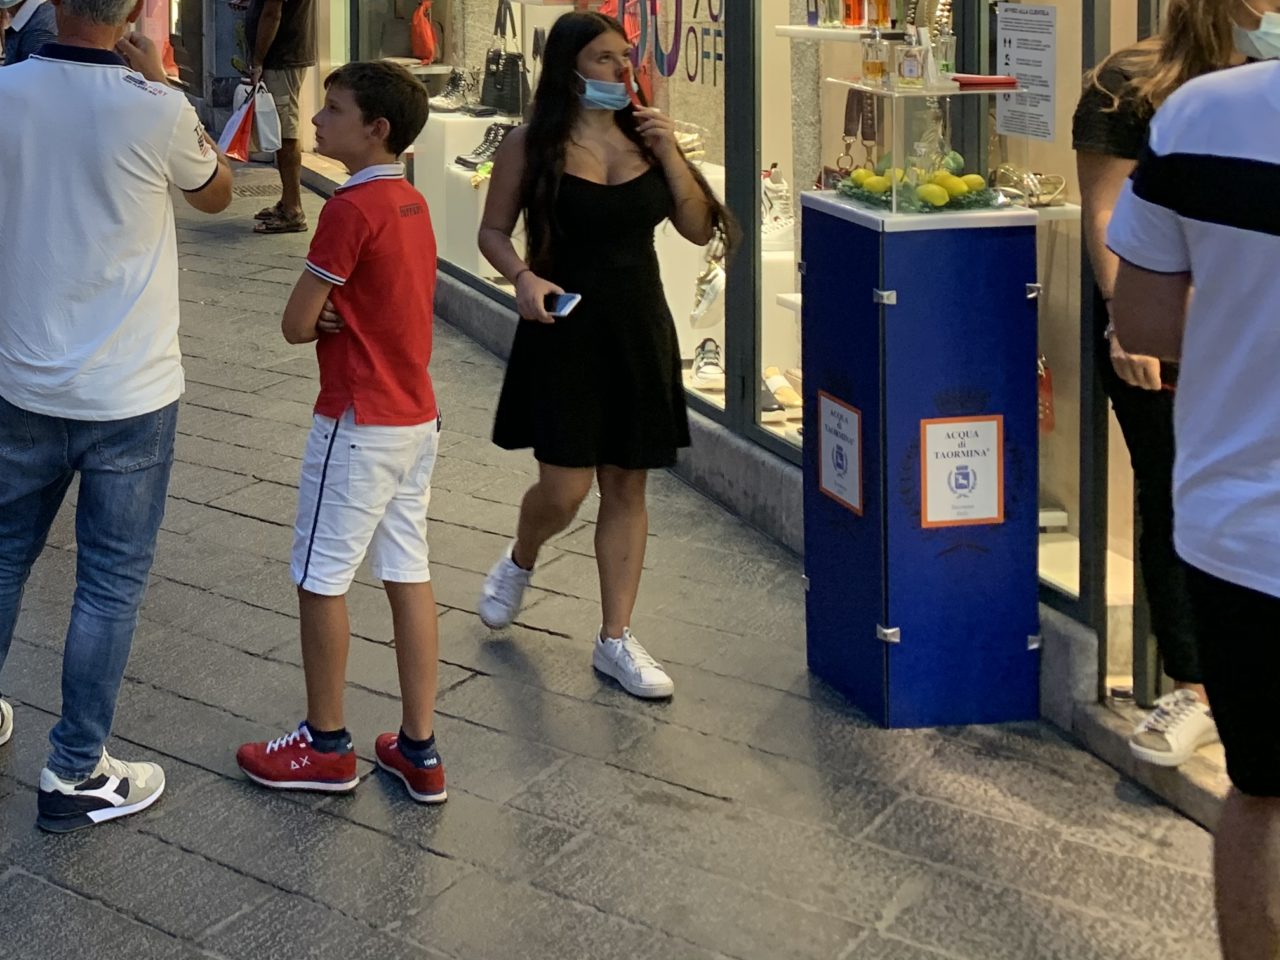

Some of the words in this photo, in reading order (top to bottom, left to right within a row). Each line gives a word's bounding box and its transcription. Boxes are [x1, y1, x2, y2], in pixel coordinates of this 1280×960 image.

[685, 26, 723, 87] OFF
[830, 408, 848, 424] ACQUA
[944, 430, 980, 440] ACQUA
